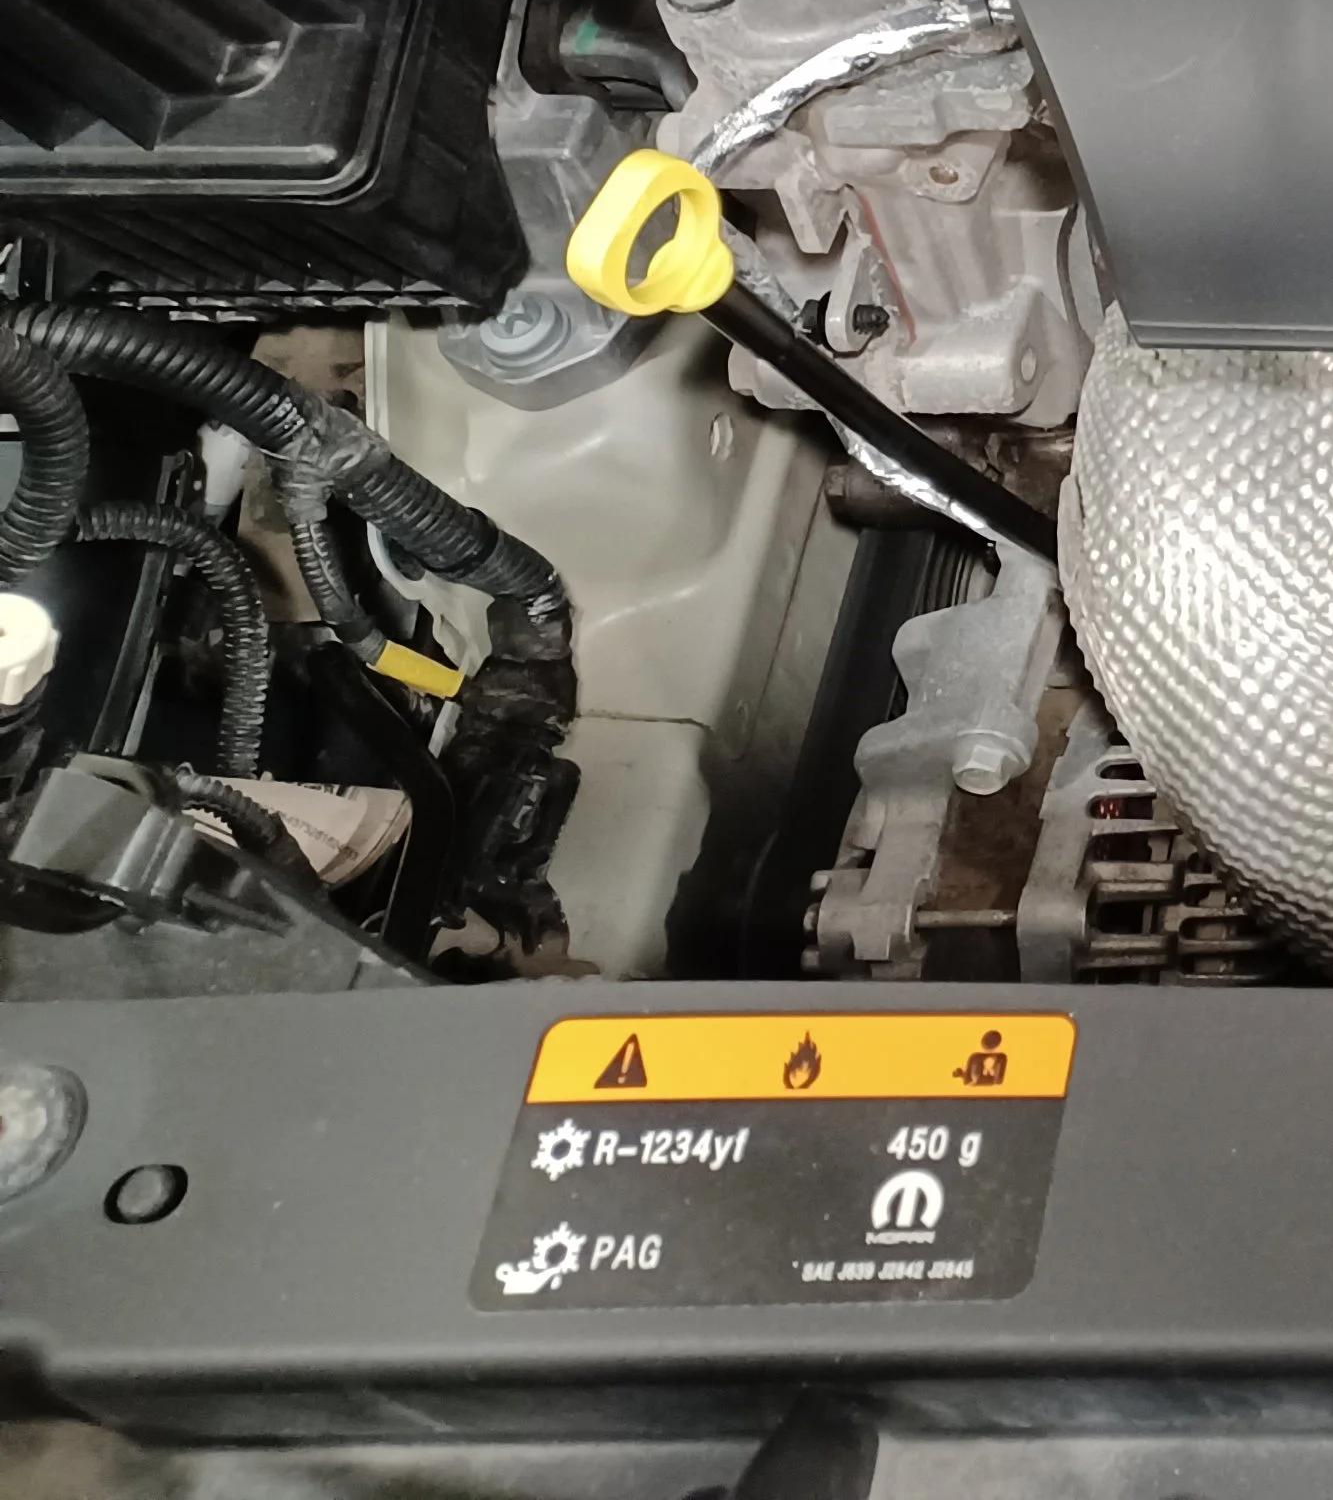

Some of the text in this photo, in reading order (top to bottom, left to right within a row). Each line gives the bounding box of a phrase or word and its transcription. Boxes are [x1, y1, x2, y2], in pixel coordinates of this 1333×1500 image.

[593, 1127, 983, 1171] R-1234yf 450 g
[590, 1234, 662, 1270] PAG
